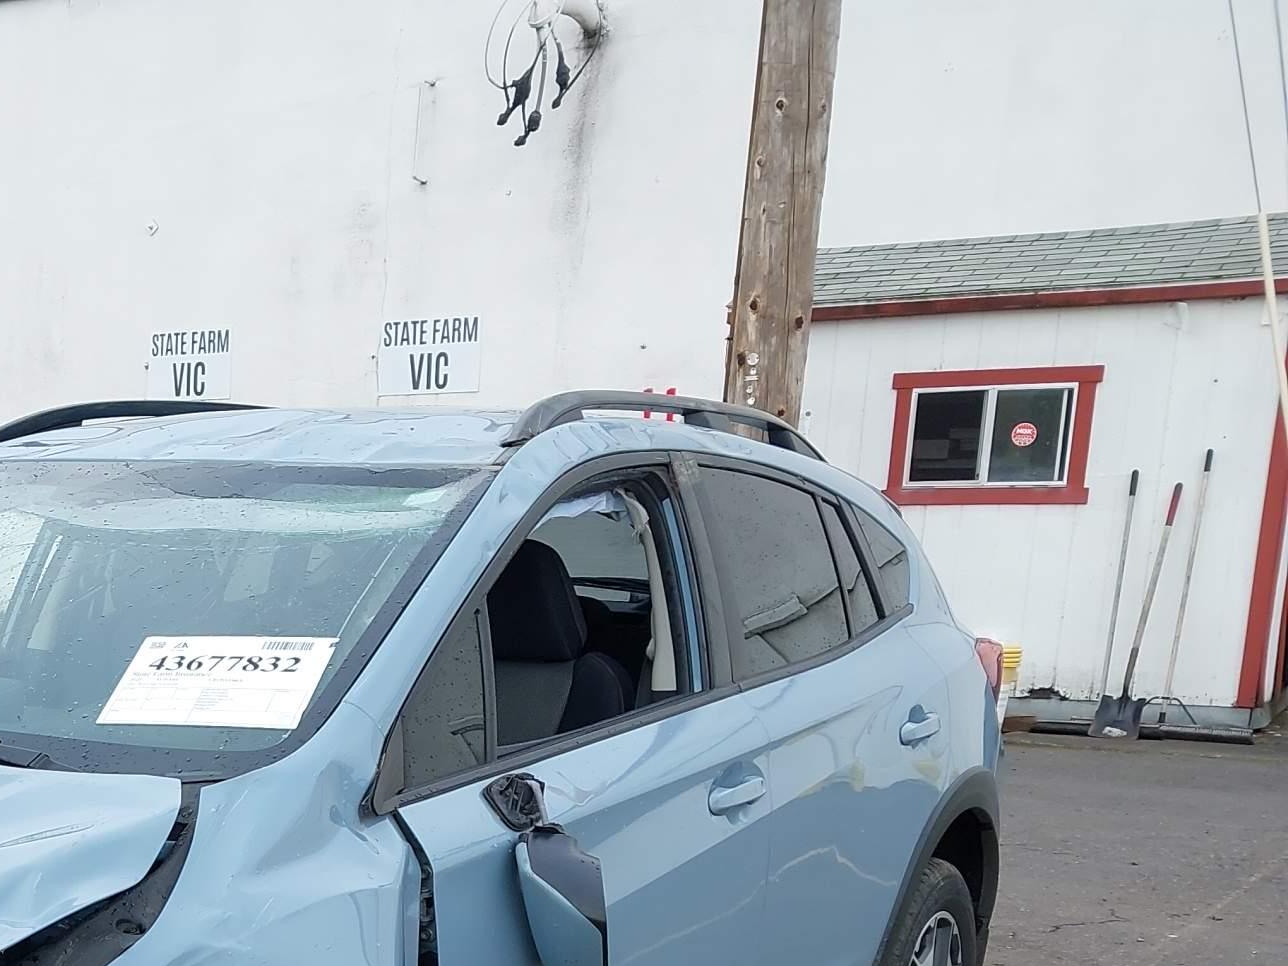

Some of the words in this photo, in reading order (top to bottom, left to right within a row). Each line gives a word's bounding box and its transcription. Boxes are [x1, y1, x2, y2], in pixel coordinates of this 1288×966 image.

[151, 332, 188, 357] STATE
[191, 329, 230, 354] FARM
[383, 318, 428, 347] STATE
[432, 316, 479, 344] FARM
[172, 361, 206, 397] VIC
[409, 351, 449, 391] VIC
[148, 655, 302, 673] 43677832
